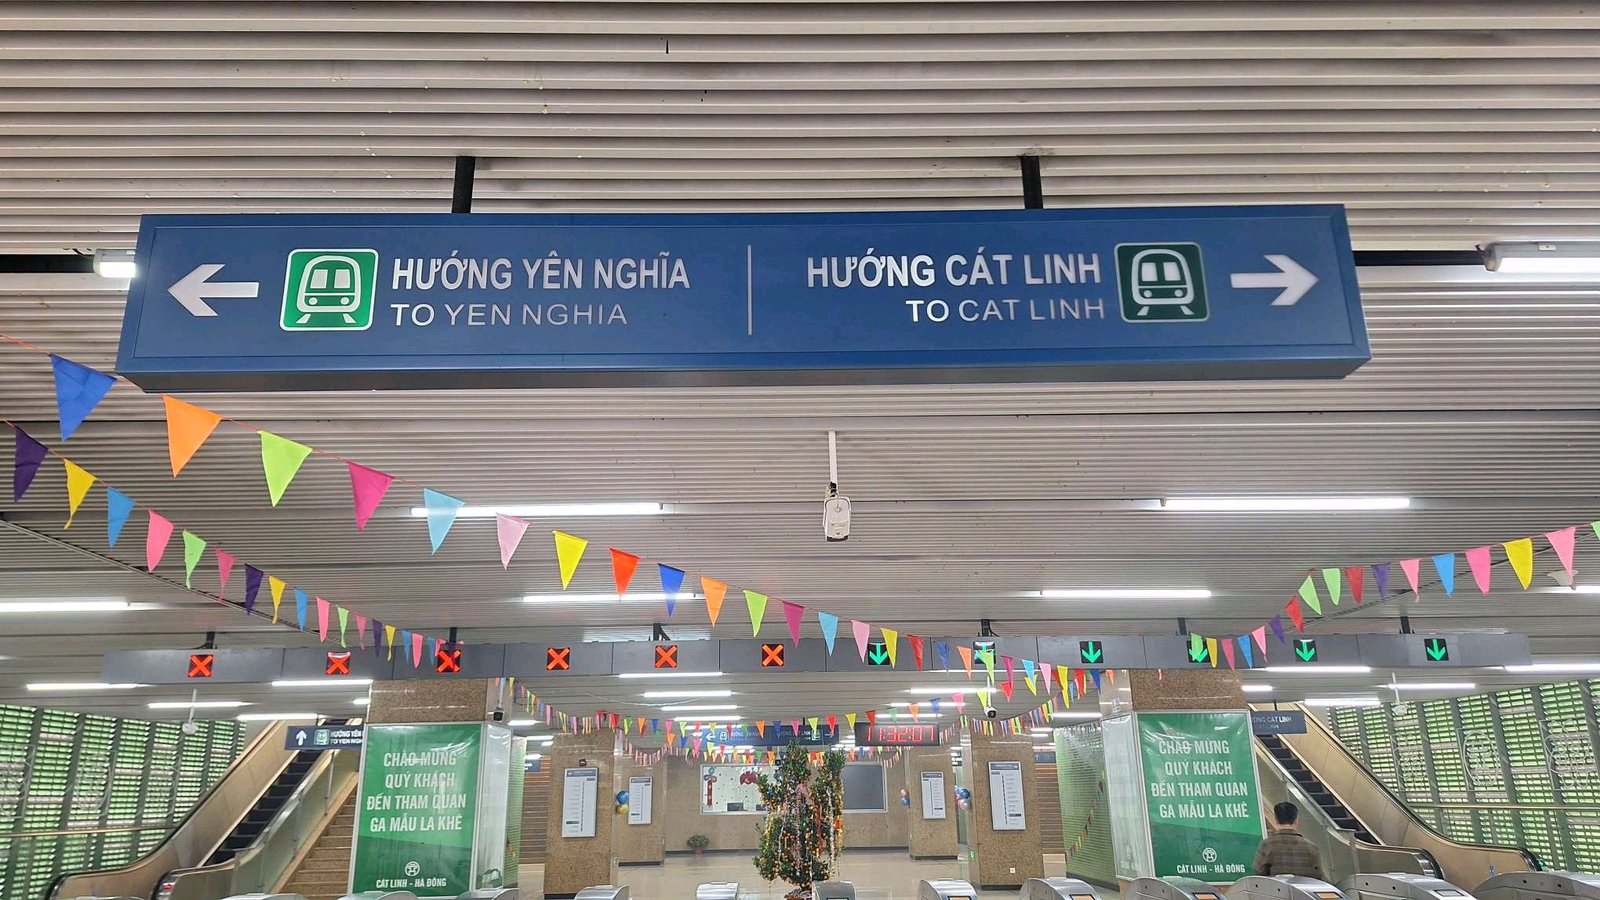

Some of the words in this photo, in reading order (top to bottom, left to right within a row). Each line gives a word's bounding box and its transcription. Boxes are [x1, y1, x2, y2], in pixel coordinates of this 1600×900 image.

[392, 250, 513, 290] HƯỚNG
[522, 250, 583, 290] YÊN
[594, 250, 691, 289] NGHĨA
[807, 248, 935, 288] HƯỚNG
[945, 247, 1012, 287] CÁT
[1024, 253, 1101, 285] LINH
[391, 303, 435, 326] TO
[444, 304, 511, 326] YEN
[521, 303, 628, 326] NGHIA
[905, 300, 949, 323] TO
[958, 299, 1019, 322] CAT
[1030, 298, 1104, 321] LINH
[1165, 759, 1189, 776] QUÝ
[1193, 759, 1233, 775] KHÁCH
[385, 771, 411, 789] QUÝ
[414, 771, 455, 788] KHÁCH
[1151, 780, 1175, 797] ĐẾN
[1178, 782, 1212, 796] THAM
[1215, 782, 1248, 796] QUAN
[366, 793, 391, 810] ĐẾN
[395, 795, 428, 810] THAM
[432, 793, 466, 809] QUAN
[1159, 804, 1175, 818] GA
[1208, 804, 1223, 818] LA
[1225, 802, 1249, 818] KHÊ
[370, 817, 386, 832] GA
[420, 816, 434, 831] LA
[438, 814, 463, 830] KHÊ
[1177, 864, 1189, 873] CÁT
[1190, 865, 1207, 873] LINH
[376, 878, 389, 888] CÁT
[390, 879, 407, 887] LINH
